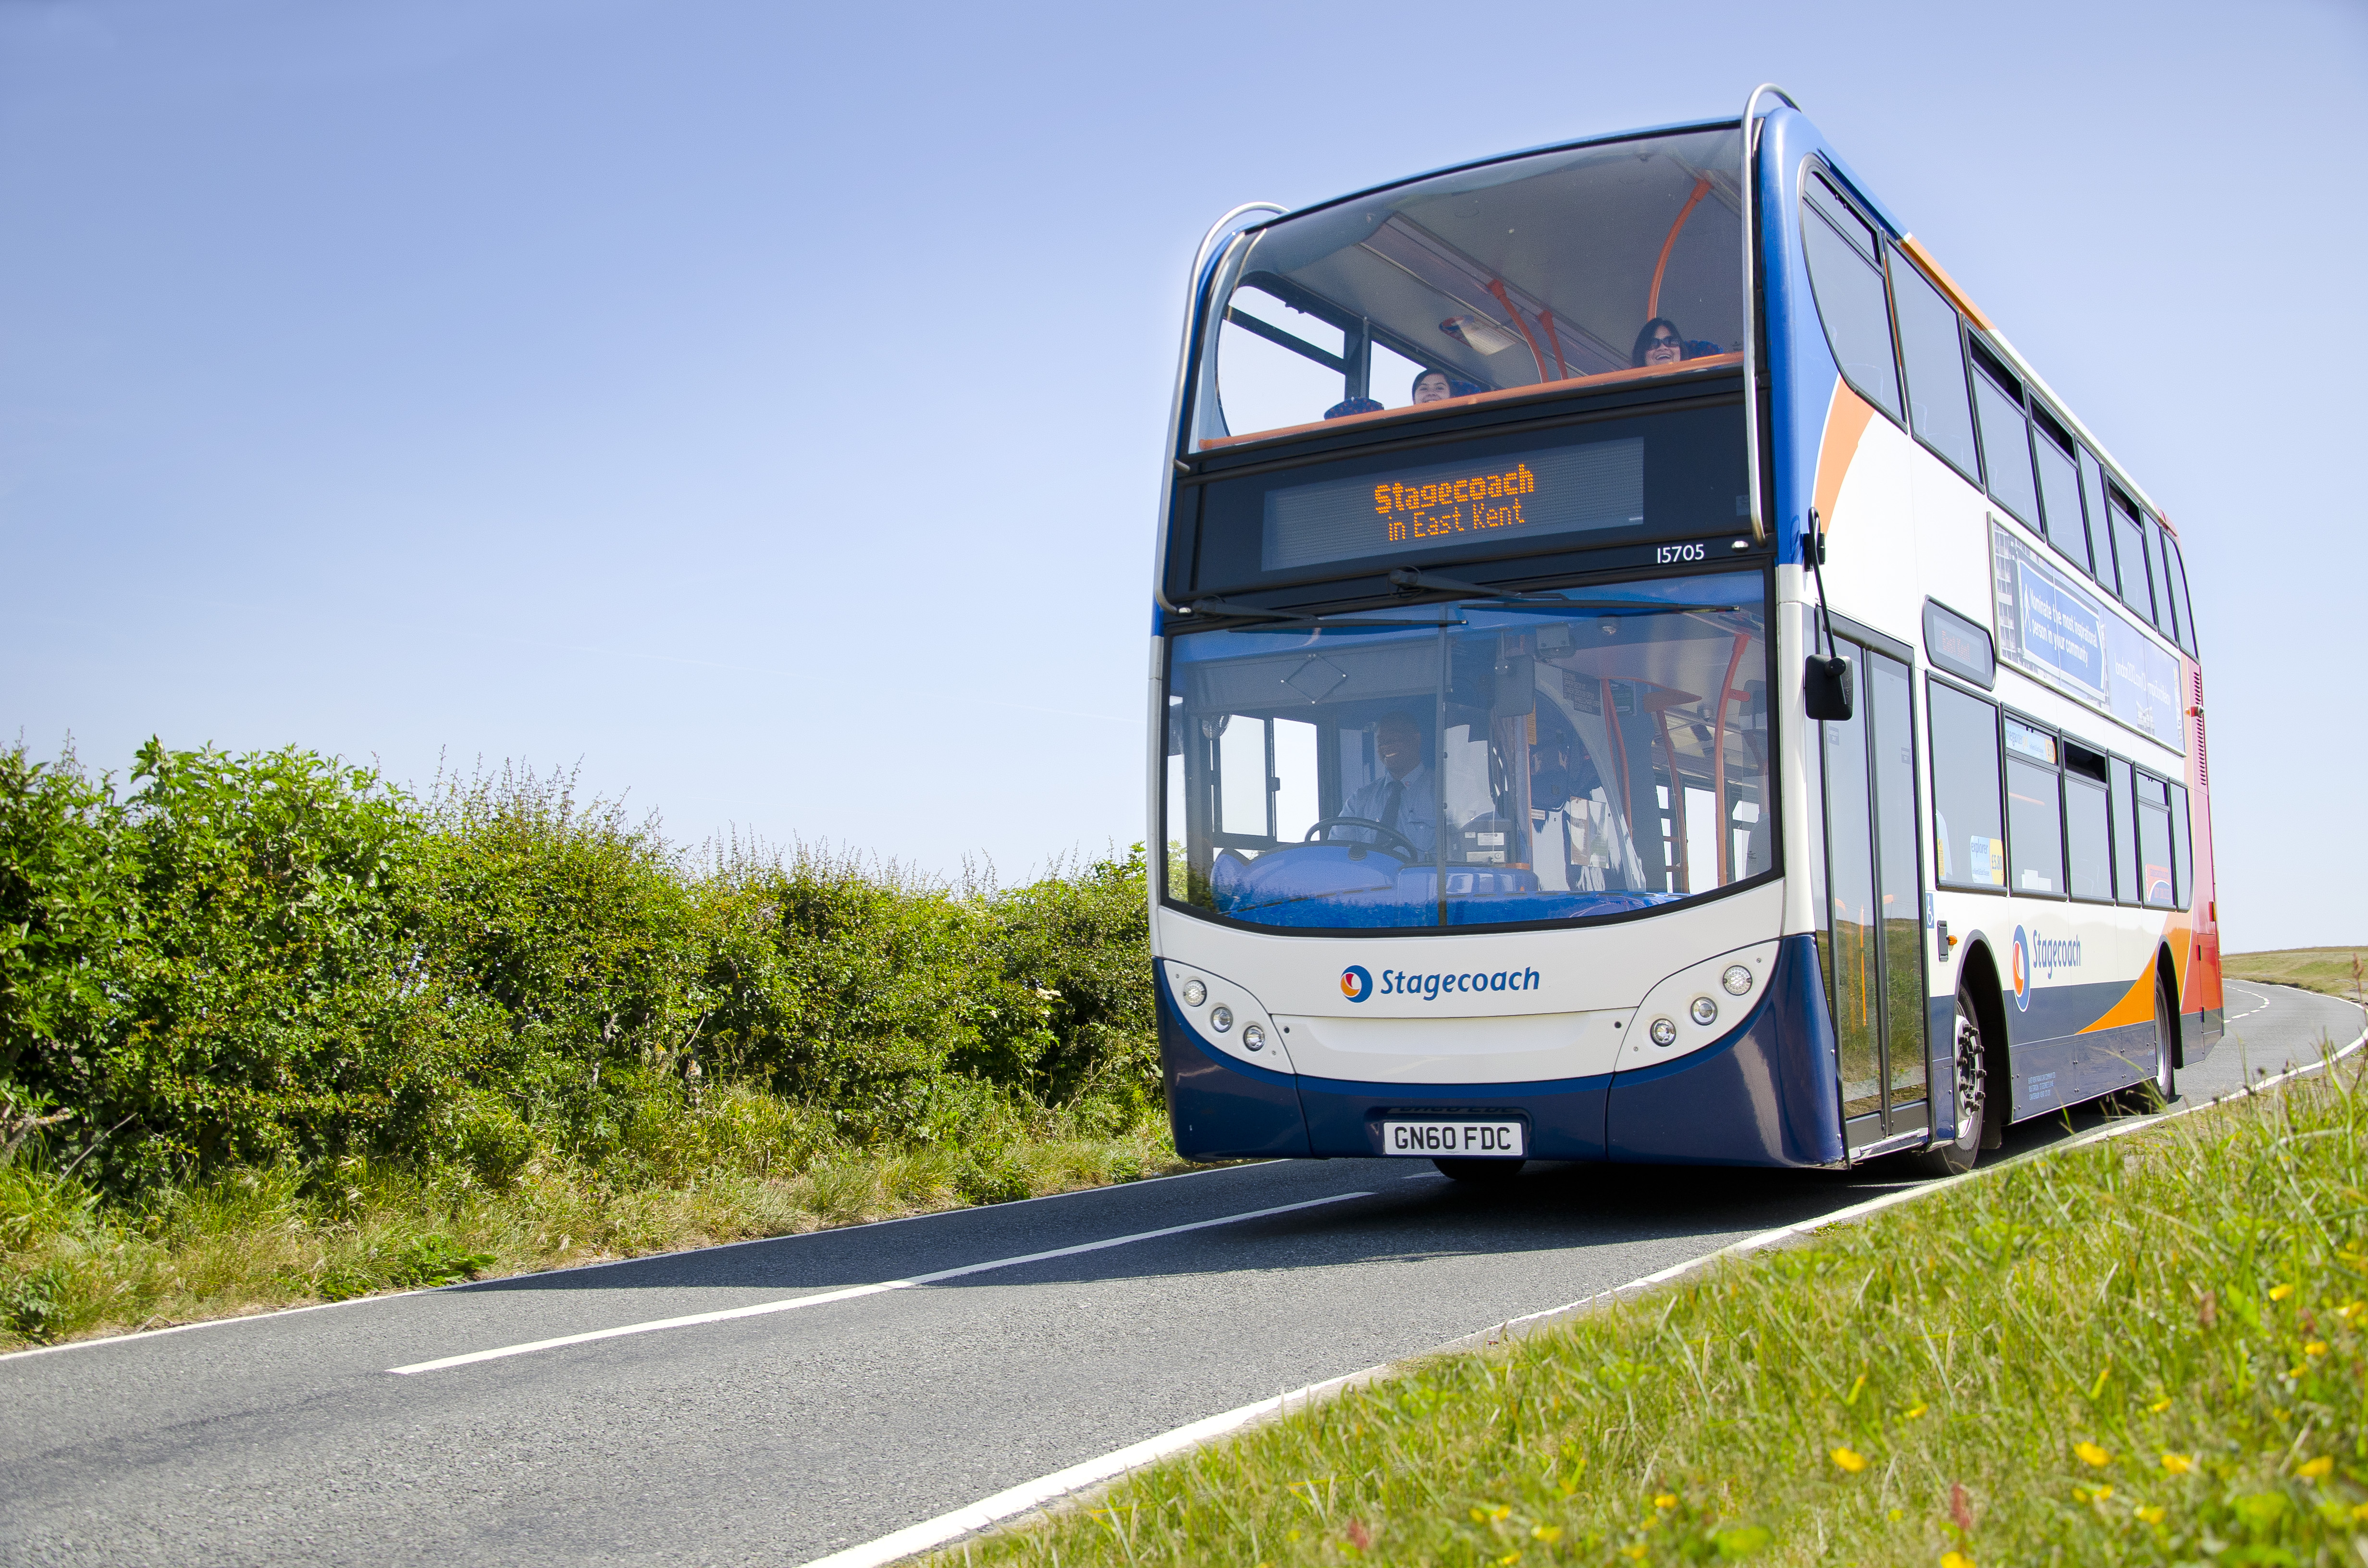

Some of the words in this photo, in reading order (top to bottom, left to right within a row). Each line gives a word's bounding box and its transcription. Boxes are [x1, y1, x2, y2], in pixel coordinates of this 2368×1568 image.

[1375, 464, 1534, 514] Stagecoach
[1388, 515, 1406, 542] in
[1413, 506, 1464, 539] East
[1472, 497, 1525, 530] Kent
[1657, 543, 1704, 564] 15705
[2030, 588, 2052, 621] Nominate
[2052, 603, 2062, 625] the
[2062, 613, 2074, 633] most
[2074, 616, 2098, 649] inspirational
[2032, 619, 2048, 642] person
[2047, 624, 2053, 645] in
[2053, 632, 2065, 651] your
[2065, 638, 2088, 668] community
[1971, 838, 1988, 858] explorer
[1991, 854, 2002, 870] £5.80
[2033, 929, 2081, 980] Stagecoach
[1380, 966, 1540, 1001] Stagecoach
[1394, 1126, 1456, 1150] GN60
[1464, 1126, 1511, 1150] FDC
